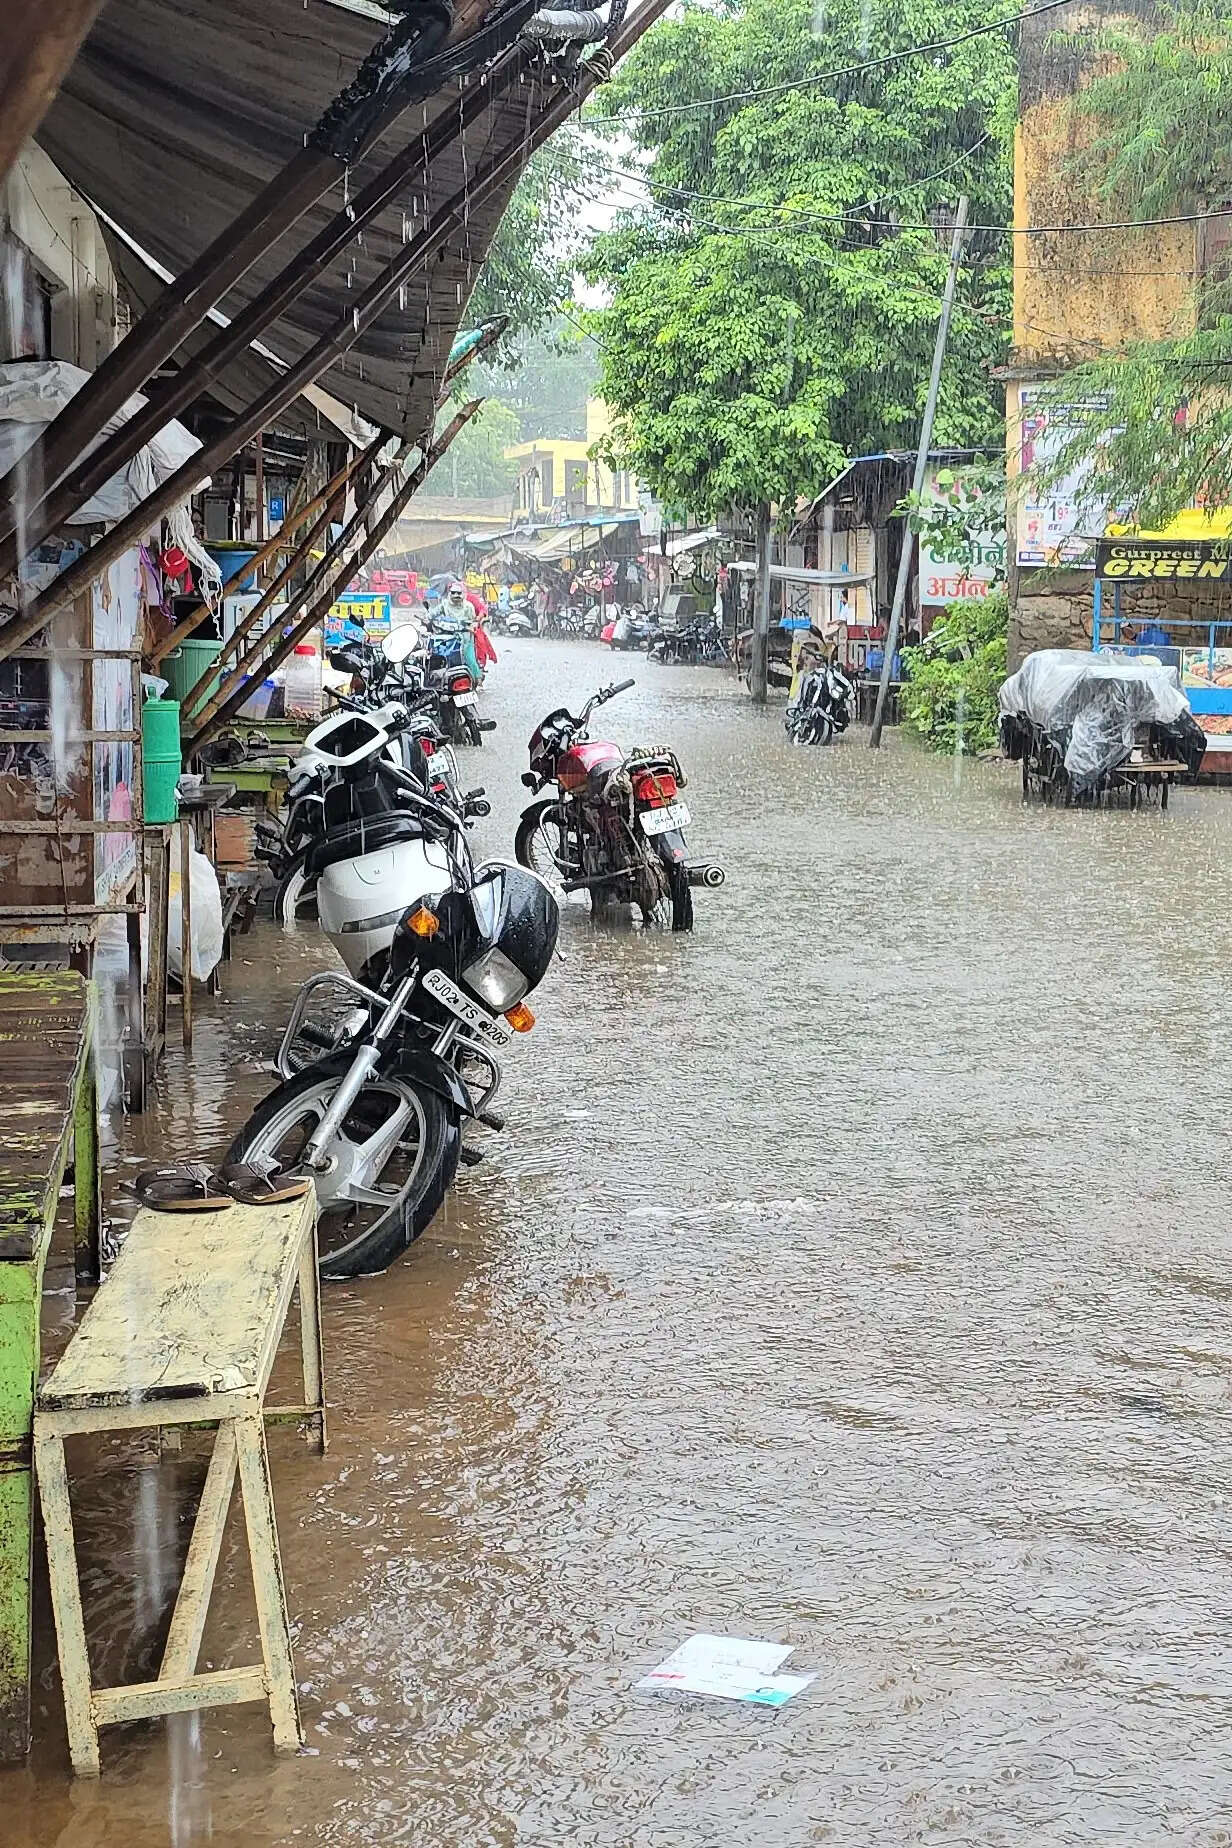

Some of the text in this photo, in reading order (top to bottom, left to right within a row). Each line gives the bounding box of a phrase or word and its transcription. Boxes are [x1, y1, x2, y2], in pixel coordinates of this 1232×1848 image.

[1110, 546, 1202, 561] Gurpreet
[1103, 559, 1228, 578] GREEN
[428, 975, 457, 1004] RJ02
[459, 1002, 479, 1020] TS
